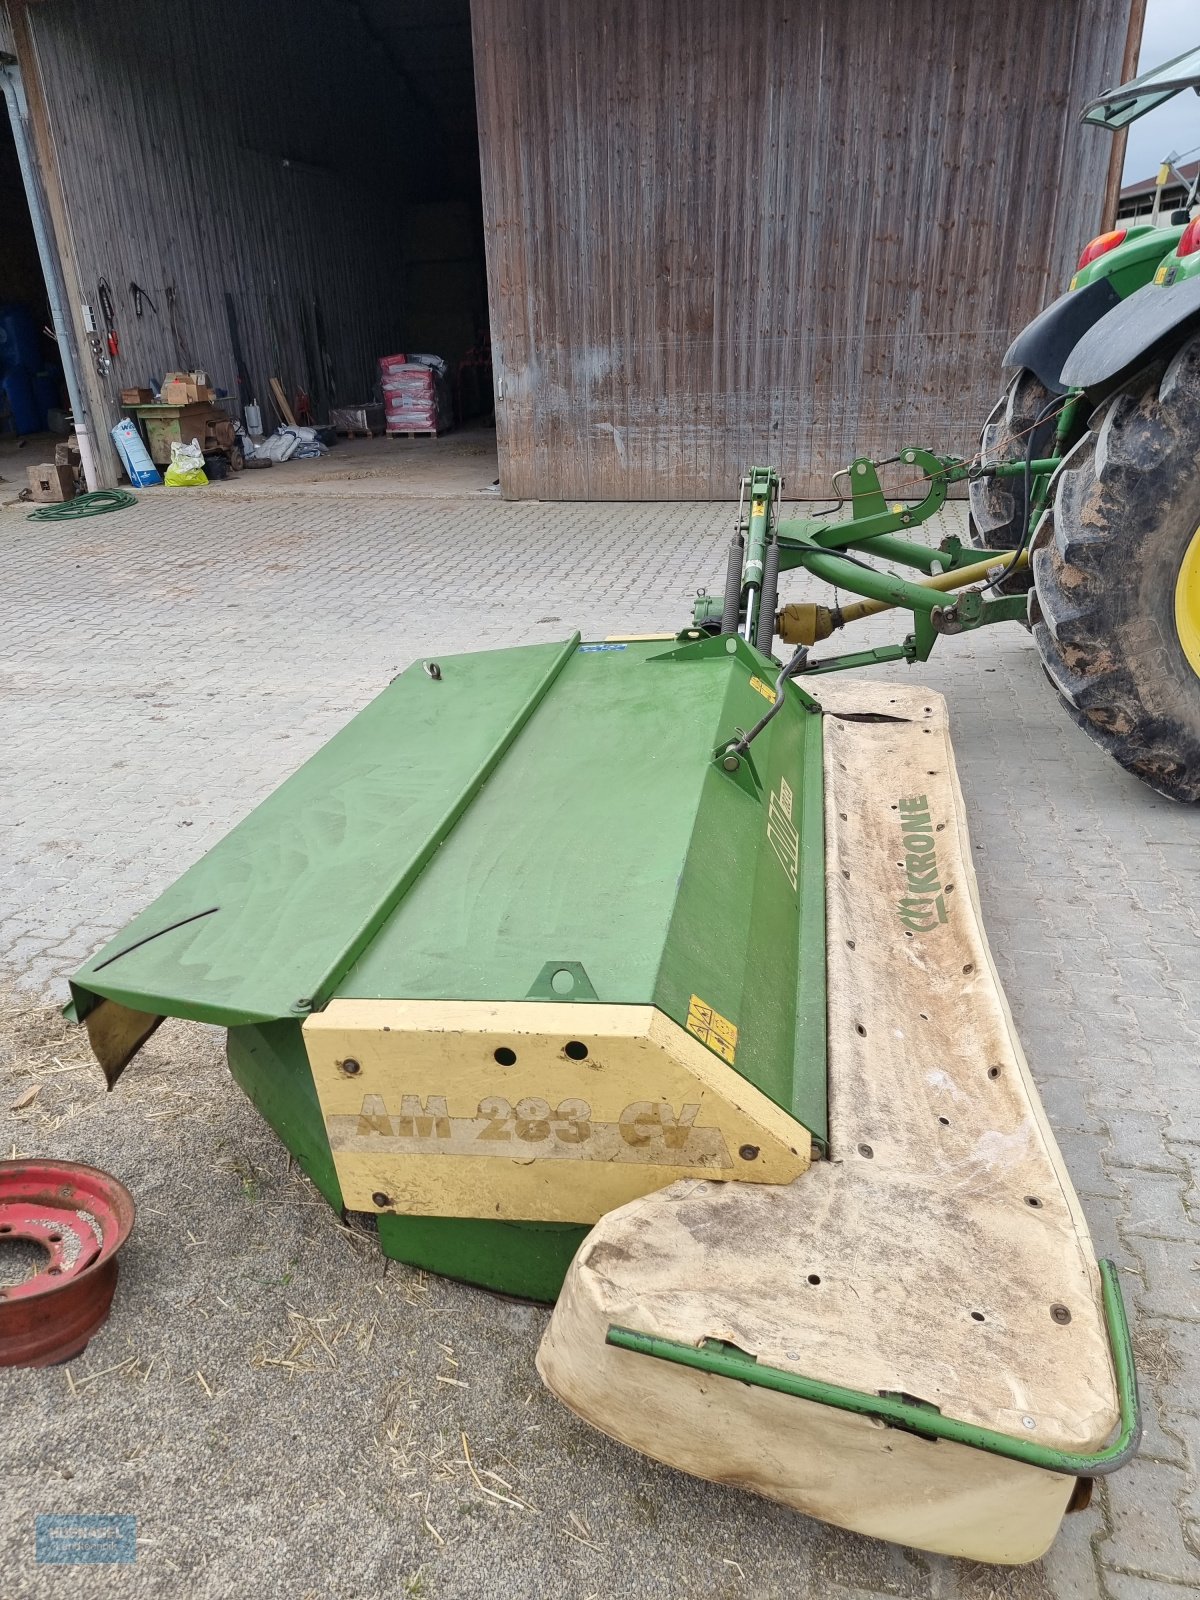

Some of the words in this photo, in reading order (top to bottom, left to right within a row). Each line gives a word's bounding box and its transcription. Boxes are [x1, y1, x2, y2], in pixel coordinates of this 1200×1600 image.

[899, 794, 940, 893] KRONE
[357, 1094, 451, 1139] AM
[476, 1096, 592, 1143] 283
[618, 1101, 701, 1149] CV
